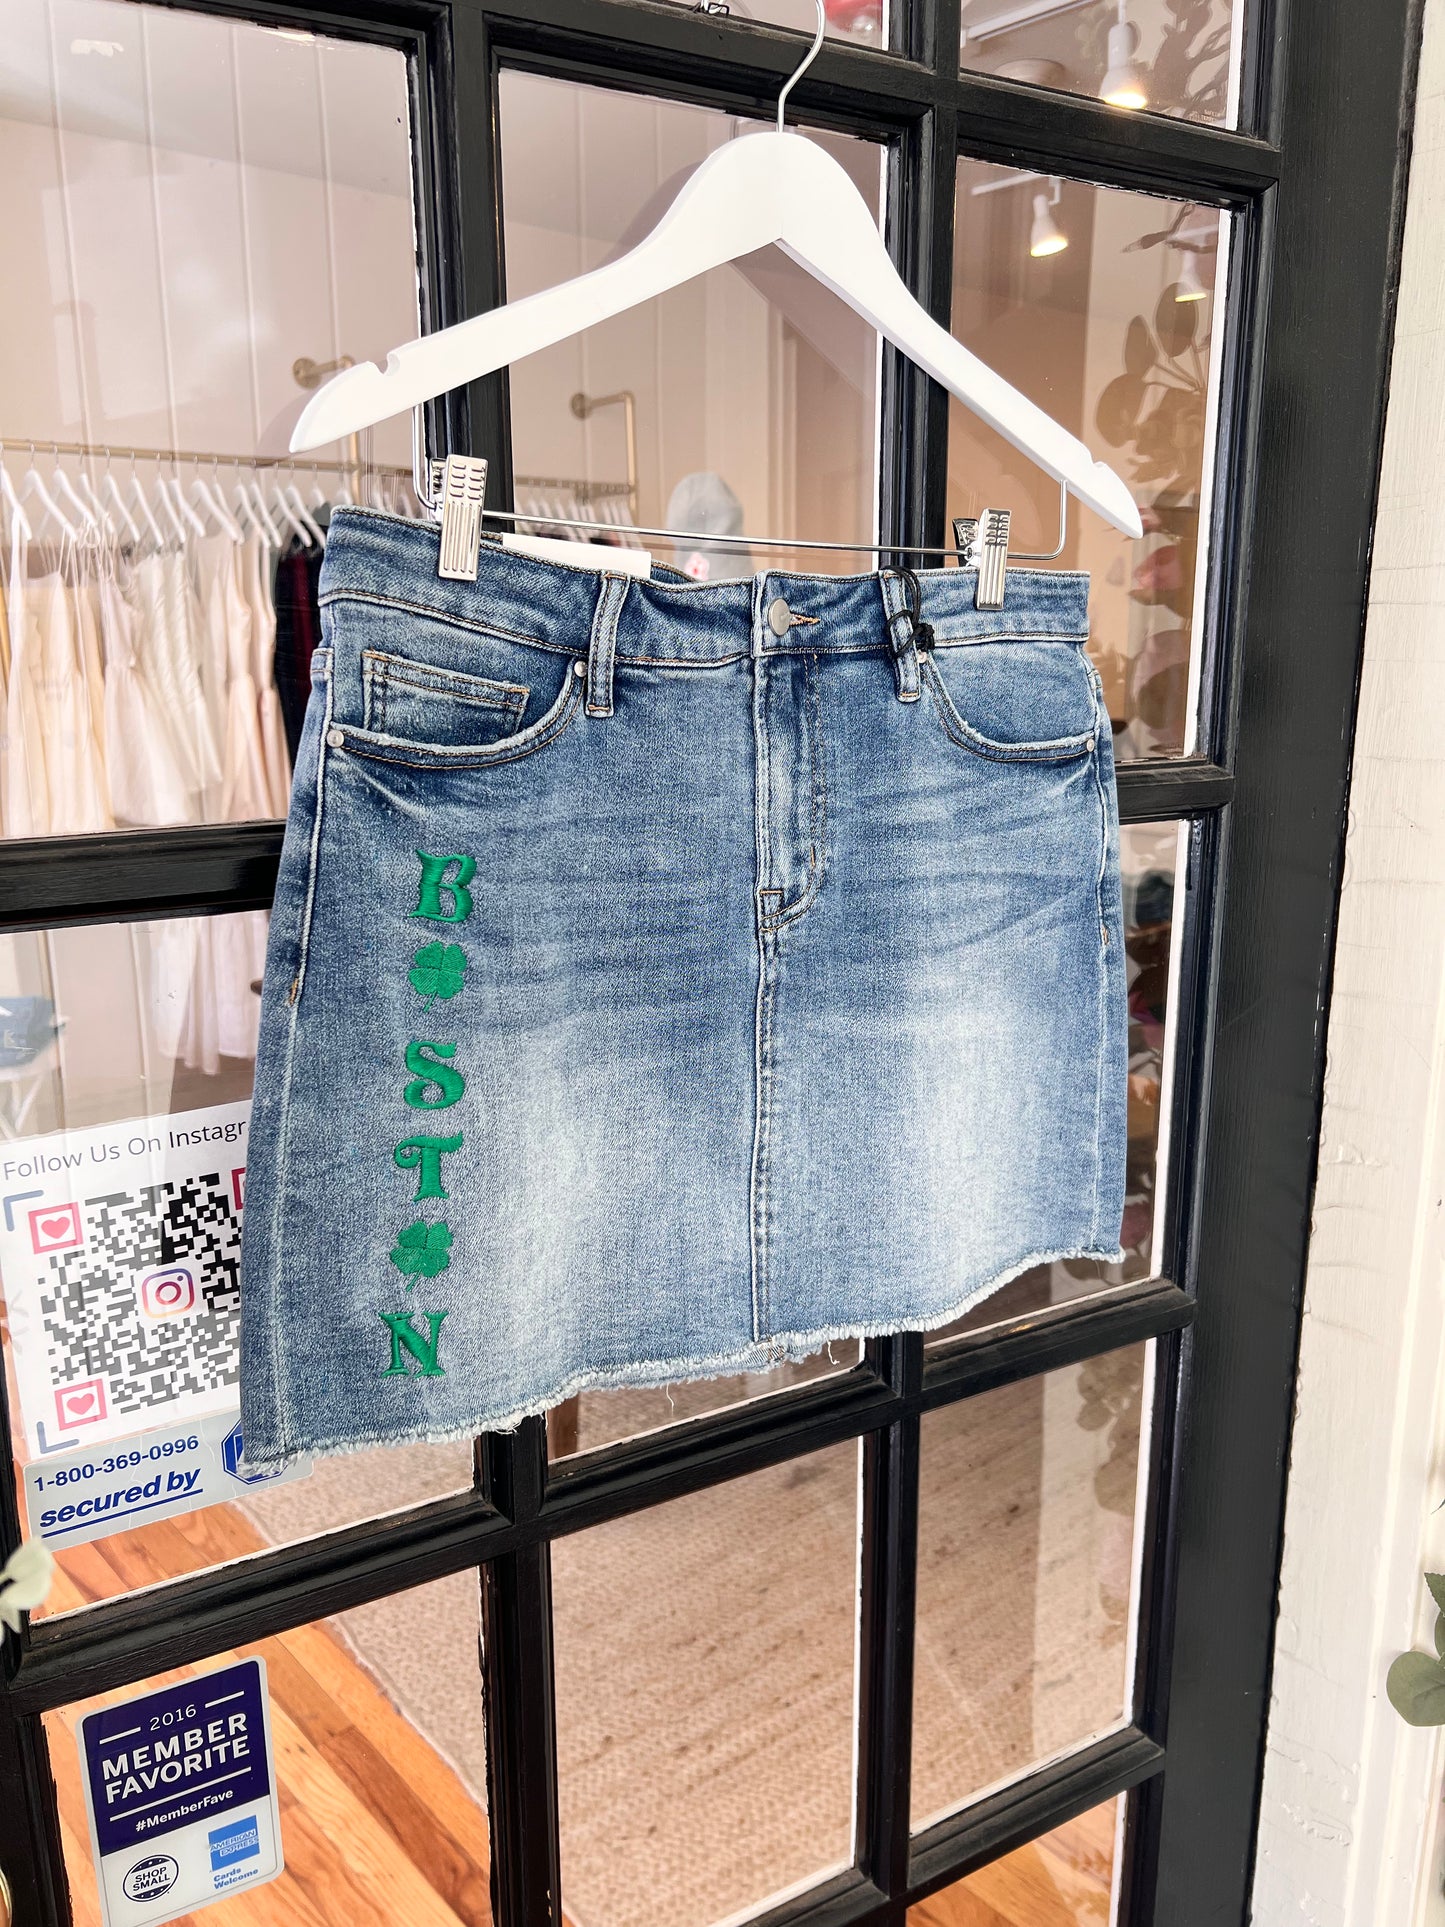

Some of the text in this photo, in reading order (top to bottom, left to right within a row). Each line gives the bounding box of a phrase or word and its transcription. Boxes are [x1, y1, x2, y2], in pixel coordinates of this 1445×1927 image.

[3, 1120, 249, 1180] Follow Us On Instagr
[34, 1435, 199, 1492] 1-800-369-0996
[40, 1468, 201, 1528] secured by
[150, 1704, 197, 1731] 2016
[102, 1712, 248, 1780] MEMBER
[106, 1734, 250, 1804] FAVORITE
[135, 1789, 234, 1832] #MemberFave
[210, 1829, 256, 1852] AMERICAN
[220, 1836, 260, 1857] EXPRESS
[133, 1874, 170, 1891] SMALL
[135, 1866, 167, 1883] SHOP
[213, 1867, 242, 1882] Cards
[214, 1868, 259, 1889] Welcome
